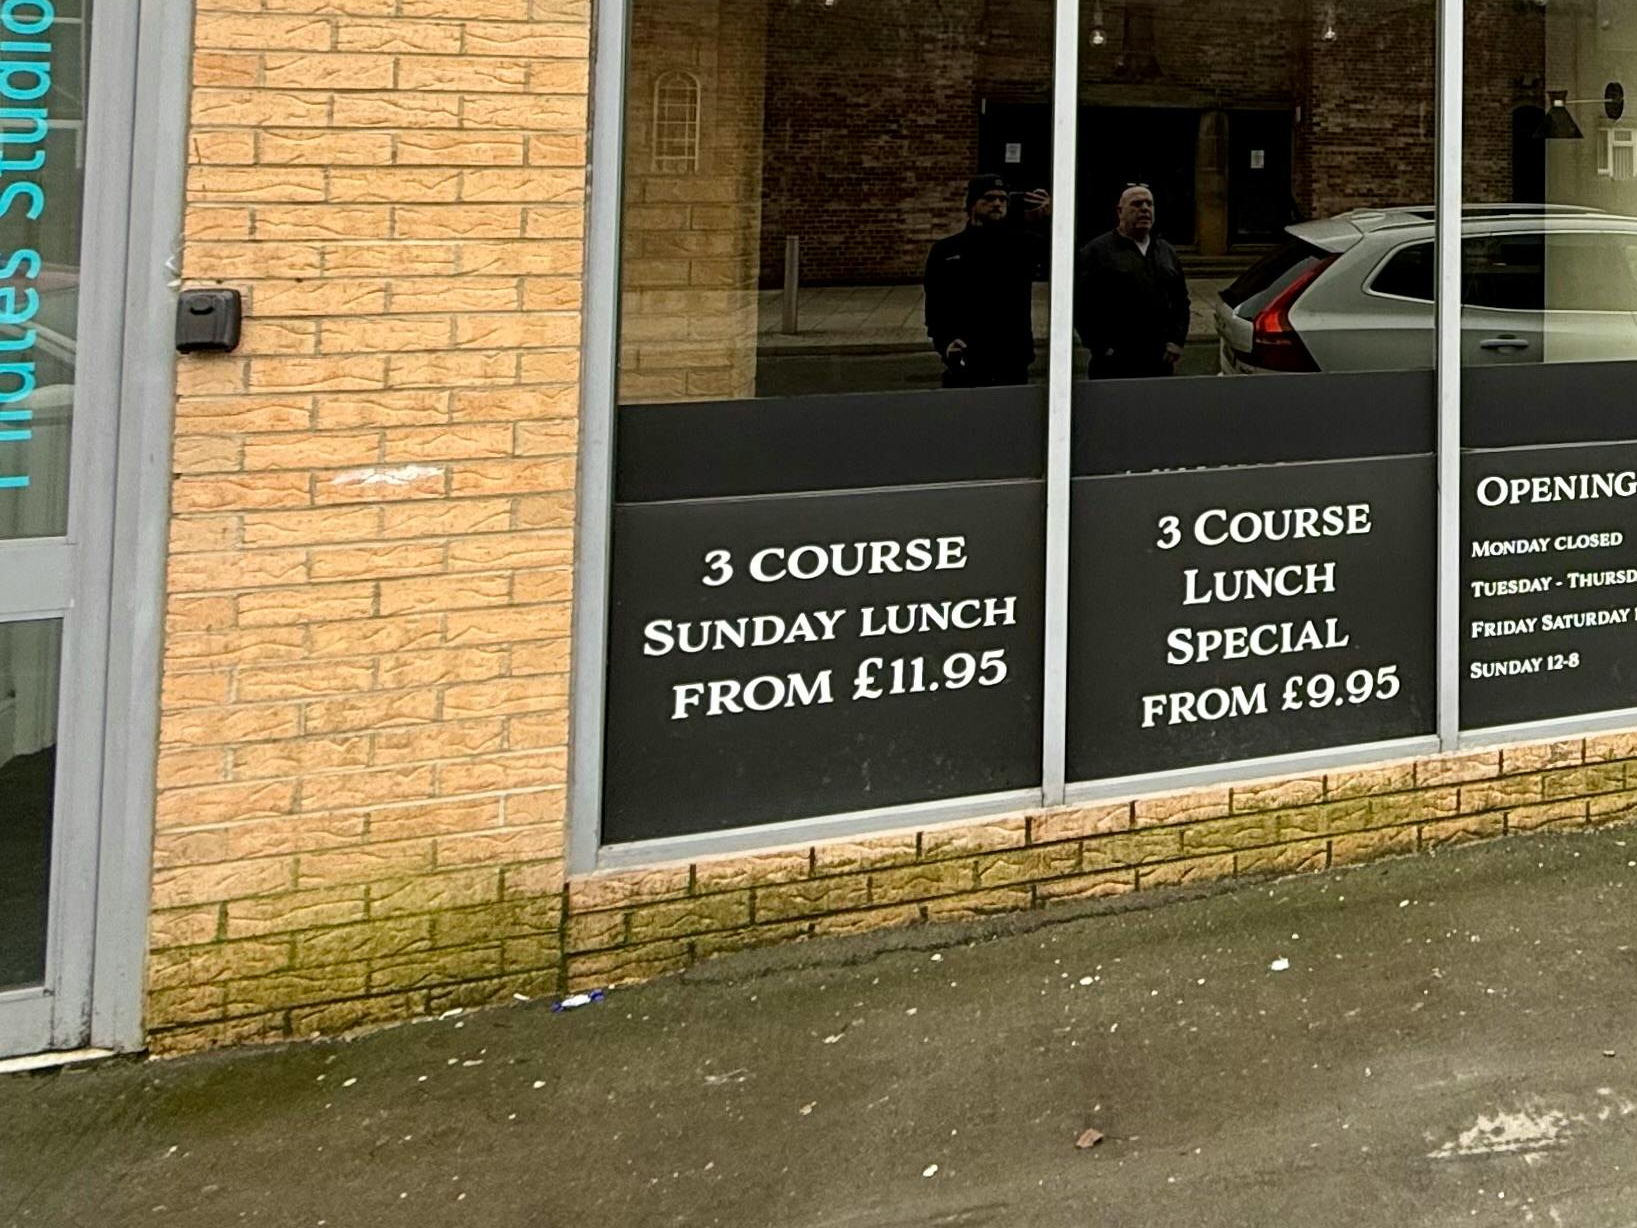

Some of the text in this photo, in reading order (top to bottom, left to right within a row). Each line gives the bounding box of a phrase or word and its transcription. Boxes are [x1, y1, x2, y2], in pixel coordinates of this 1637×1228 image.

[1156, 503, 1373, 550] 3 COURSE
[1471, 532, 1624, 558] MONDAY CLOSED
[702, 536, 968, 586] 3 COURSE
[1182, 561, 1337, 606] LUNCH
[1471, 576, 1553, 598] TUESDAY
[642, 596, 1018, 657] SUNDAY LUNCH
[1166, 617, 1350, 665] SPECIAL
[1471, 618, 1538, 639] FRIDAY
[1541, 608, 1632, 631] SATURDAY
[670, 648, 1008, 721] FROM £11.95
[1470, 652, 1580, 679] SUNDAY 12-8
[1140, 664, 1401, 728] FROM £9.95
